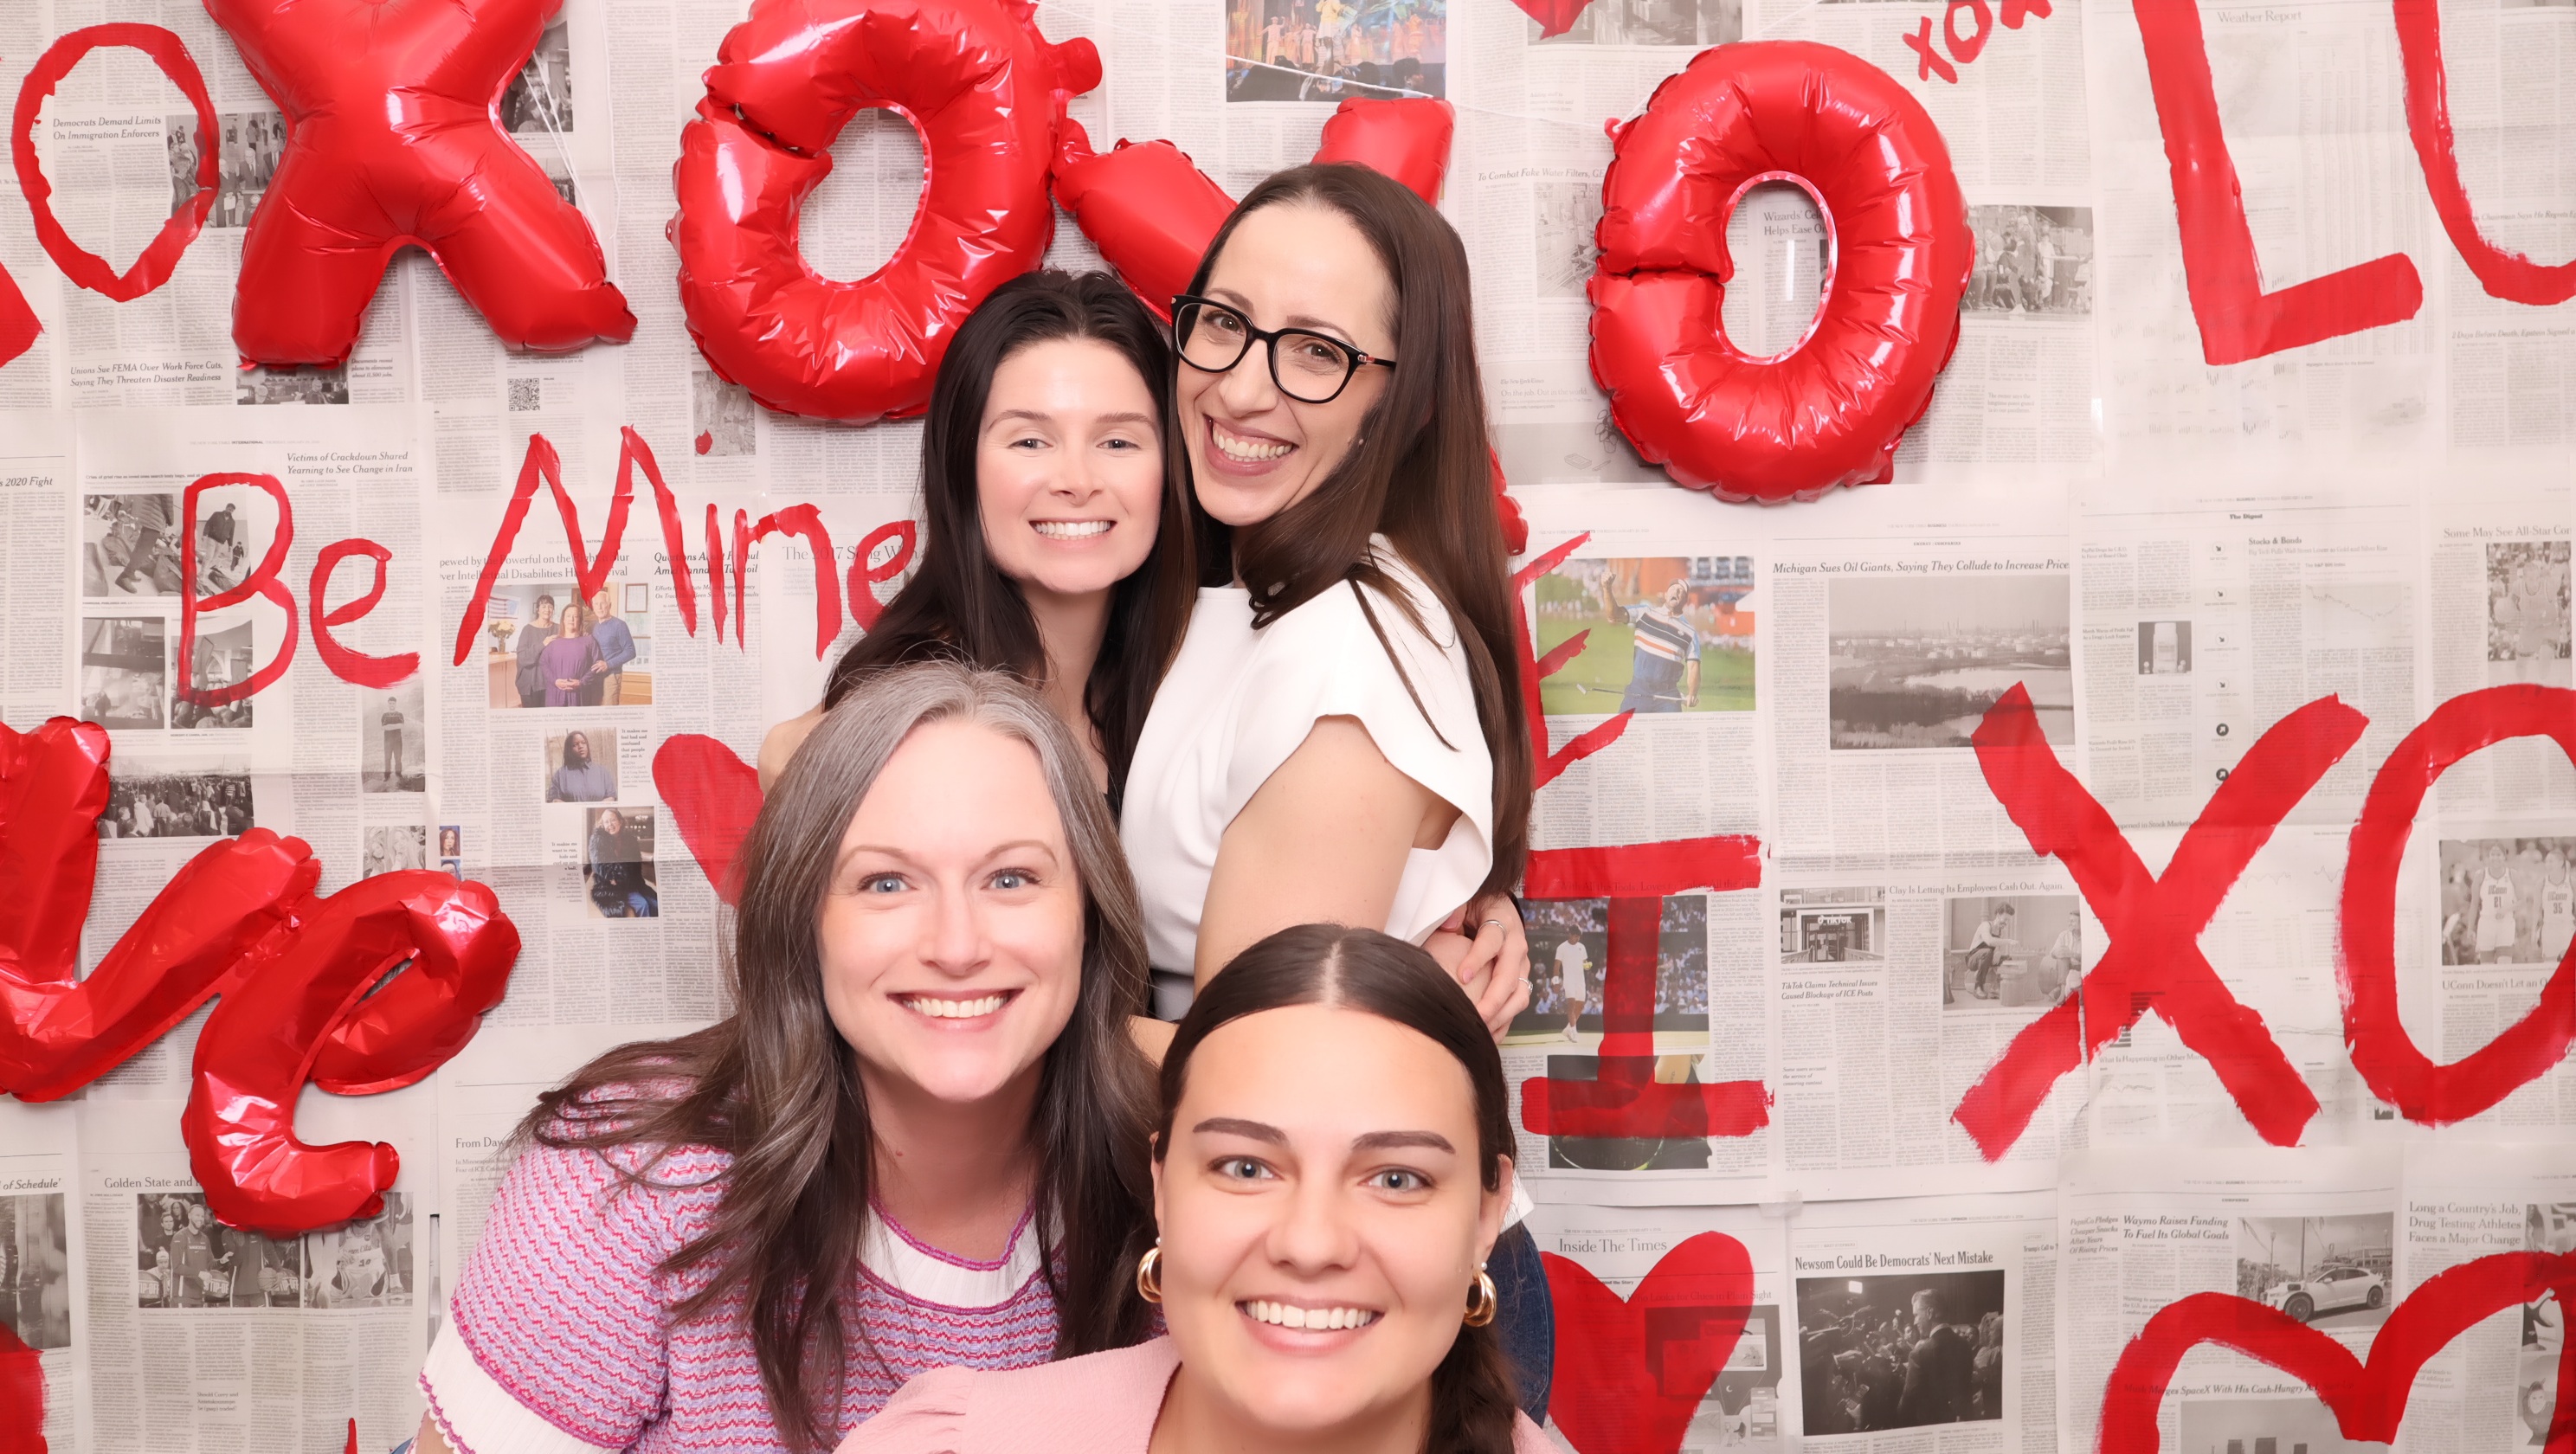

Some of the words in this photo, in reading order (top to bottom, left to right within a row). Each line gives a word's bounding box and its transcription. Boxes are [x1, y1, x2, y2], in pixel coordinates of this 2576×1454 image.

[2217, 11, 2263, 23] Weather
[2265, 10, 2302, 23] Report
[53, 119, 96, 127] Democrats
[98, 116, 133, 125] Demand
[135, 116, 161, 125] Limits
[54, 132, 66, 140] On
[68, 130, 119, 140] Immigration
[121, 130, 159, 138] Enforcers
[1489, 170, 1518, 179] Combat
[1566, 169, 1590, 178] Filters,
[1764, 226, 1789, 236] Helps
[1792, 224, 1812, 235] Ease
[70, 366, 95, 375] Unions
[97, 364, 110, 373] Sue
[112, 364, 138, 372] FEMA
[184, 361, 203, 370] Force
[205, 360, 223, 370] Cuts,
[70, 378, 94, 387] Saying
[97, 377, 113, 386] They
[187, 373, 222, 382] Readiness
[287, 453, 318, 461] Victims
[320, 452, 330, 461] of
[330, 451, 377, 460] Crackdown
[379, 451, 408, 460] Shared
[287, 465, 323, 476] Yearning
[336, 465, 351, 473] See
[352, 464, 383, 474] Change
[396, 464, 413, 473] Iran
[5, 478, 27, 486] 2020
[29, 476, 53, 487] Fight
[2444, 527, 2470, 538] Some
[2473, 526, 2493, 539] May
[2496, 526, 2513, 537] See
[2249, 537, 2270, 545] Stocks
[2272, 537, 2278, 545] &
[2281, 536, 2302, 544] Bonds
[782, 547, 808, 560] The
[178, 471, 422, 709] Be
[453, 423, 919, 668] Mine
[471, 557, 481, 568] by
[557, 553, 571, 563] the
[512, 567, 563, 579] Disabilities
[1773, 563, 1817, 575] Michigan
[1819, 563, 1841, 572] Sues
[1844, 562, 1858, 572] Oil
[1860, 562, 1893, 573] Giants,
[1896, 562, 1928, 573] Saying
[1931, 561, 1954, 572] They
[1956, 560, 1992, 571] Collude
[1994, 561, 2003, 569] to
[2006, 560, 2044, 569] Increase
[1889, 885, 1905, 896] Clay
[1909, 885, 1916, 894] Is
[1917, 885, 1945, 895] Letting
[1947, 885, 1955, 893] Its
[1957, 884, 1997, 894] Employees
[1999, 882, 2018, 891] Cash
[2019, 882, 2037, 891] Out.
[2038, 881, 2063, 891] Again.
[2494, 897, 2502, 908] 21
[2553, 903, 2563, 914] 35
[1781, 981, 1803, 990] TikTok
[2443, 980, 2474, 990] UConn
[2476, 979, 2509, 989] Doesn't
[2510, 979, 2524, 988] Let
[1805, 990, 1834, 1000] Blockage
[456, 1138, 480, 1148] From
[3, 1181, 13, 1190] of
[15, 1178, 61, 1190] Schedule'
[105, 1178, 142, 1188] Golden
[145, 1176, 171, 1187] State
[173, 1176, 193, 1187] and
[2409, 1201, 2437, 1214] Long
[2447, 1202, 2497, 1215] Country's
[2499, 1203, 2521, 1215] Job,
[2123, 1215, 2157, 1227] Waymo
[2159, 1216, 2188, 1226] Raises
[2190, 1215, 2229, 1228] Funding
[2409, 1216, 2437, 1229] Drug
[2438, 1217, 2476, 1231] Testing
[2478, 1218, 2521, 1230] Athletes
[2123, 1229, 2134, 1238] To
[2135, 1230, 2155, 1238] Fuel
[2157, 1229, 2168, 1238] Its
[2171, 1229, 2199, 1239] Global
[2203, 1230, 2229, 1240] Goals
[2409, 1232, 2438, 1243] Faces
[2448, 1232, 2479, 1245] Major
[2482, 1233, 2521, 1246] Change
[1559, 1238, 1597, 1253] Inside
[1599, 1238, 1626, 1252] The
[1627, 1238, 1667, 1252] Times
[1795, 1257, 1834, 1271] Newsom
[1837, 1255, 1863, 1269] Could
[1865, 1254, 1877, 1268] Be
[1880, 1252, 1932, 1267] Democrats'
[1934, 1252, 1955, 1265] Next
[1957, 1251, 1993, 1264] Mistake
[1750, 1290, 1772, 1302] Sight
[2180, 1385, 2210, 1396] SpaceX
[2213, 1384, 2232, 1393] With
[2235, 1384, 2249, 1393] His
[2251, 1384, 2302, 1394] Cash-Hungry
